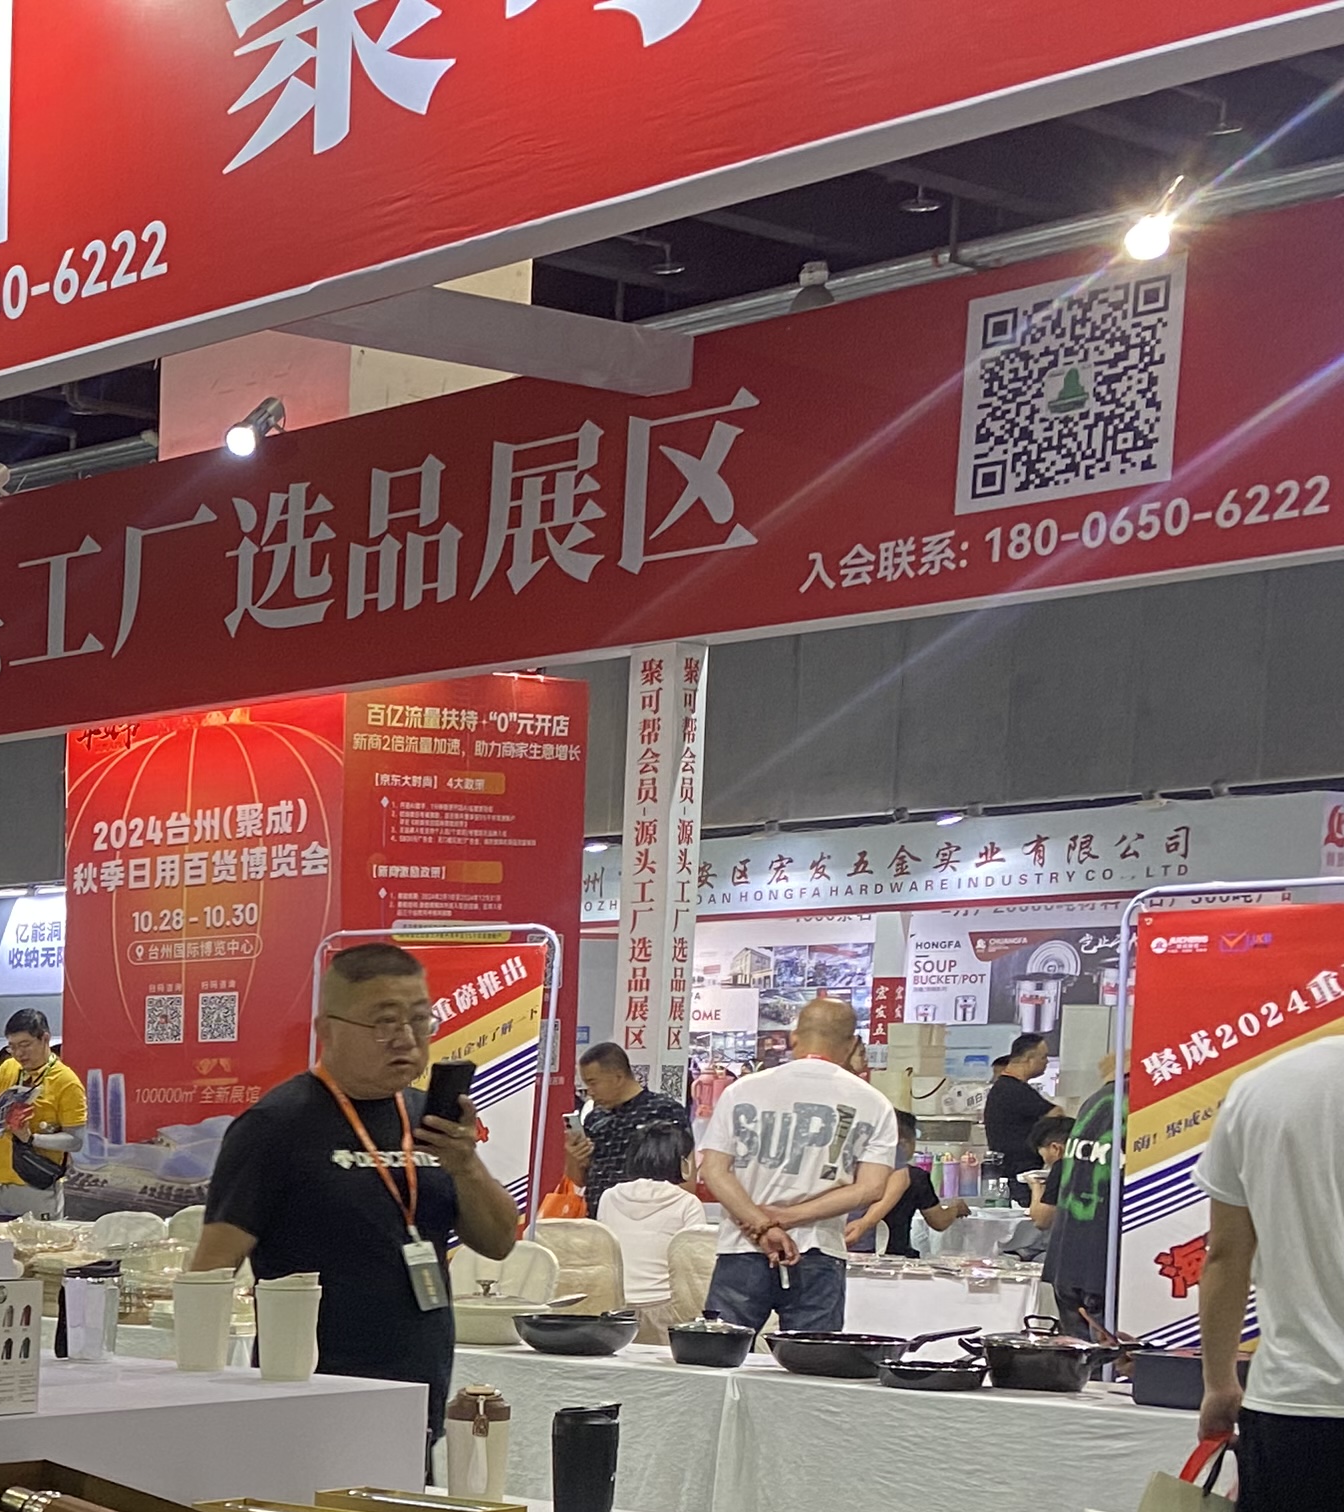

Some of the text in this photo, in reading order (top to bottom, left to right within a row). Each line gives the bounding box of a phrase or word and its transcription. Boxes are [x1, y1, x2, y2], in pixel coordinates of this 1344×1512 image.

[799, 475, 1331, 595] 入会联系: 180-0650-6222
[72, 840, 330, 895] 秋季日用百货博览会
[829, 878, 949, 897] HARDWARE
[956, 870, 1076, 890] INDUSTRY
[739, 886, 821, 903] HONGFA
[14, 921, 65, 943] 亿能洞
[147, 939, 254, 961] 台州国际博览中心
[915, 939, 962, 950] HONGFA
[913, 959, 957, 974] SOUP
[913, 973, 987, 985] BUCKET/POT
[874, 985, 889, 1044] 宏发五
